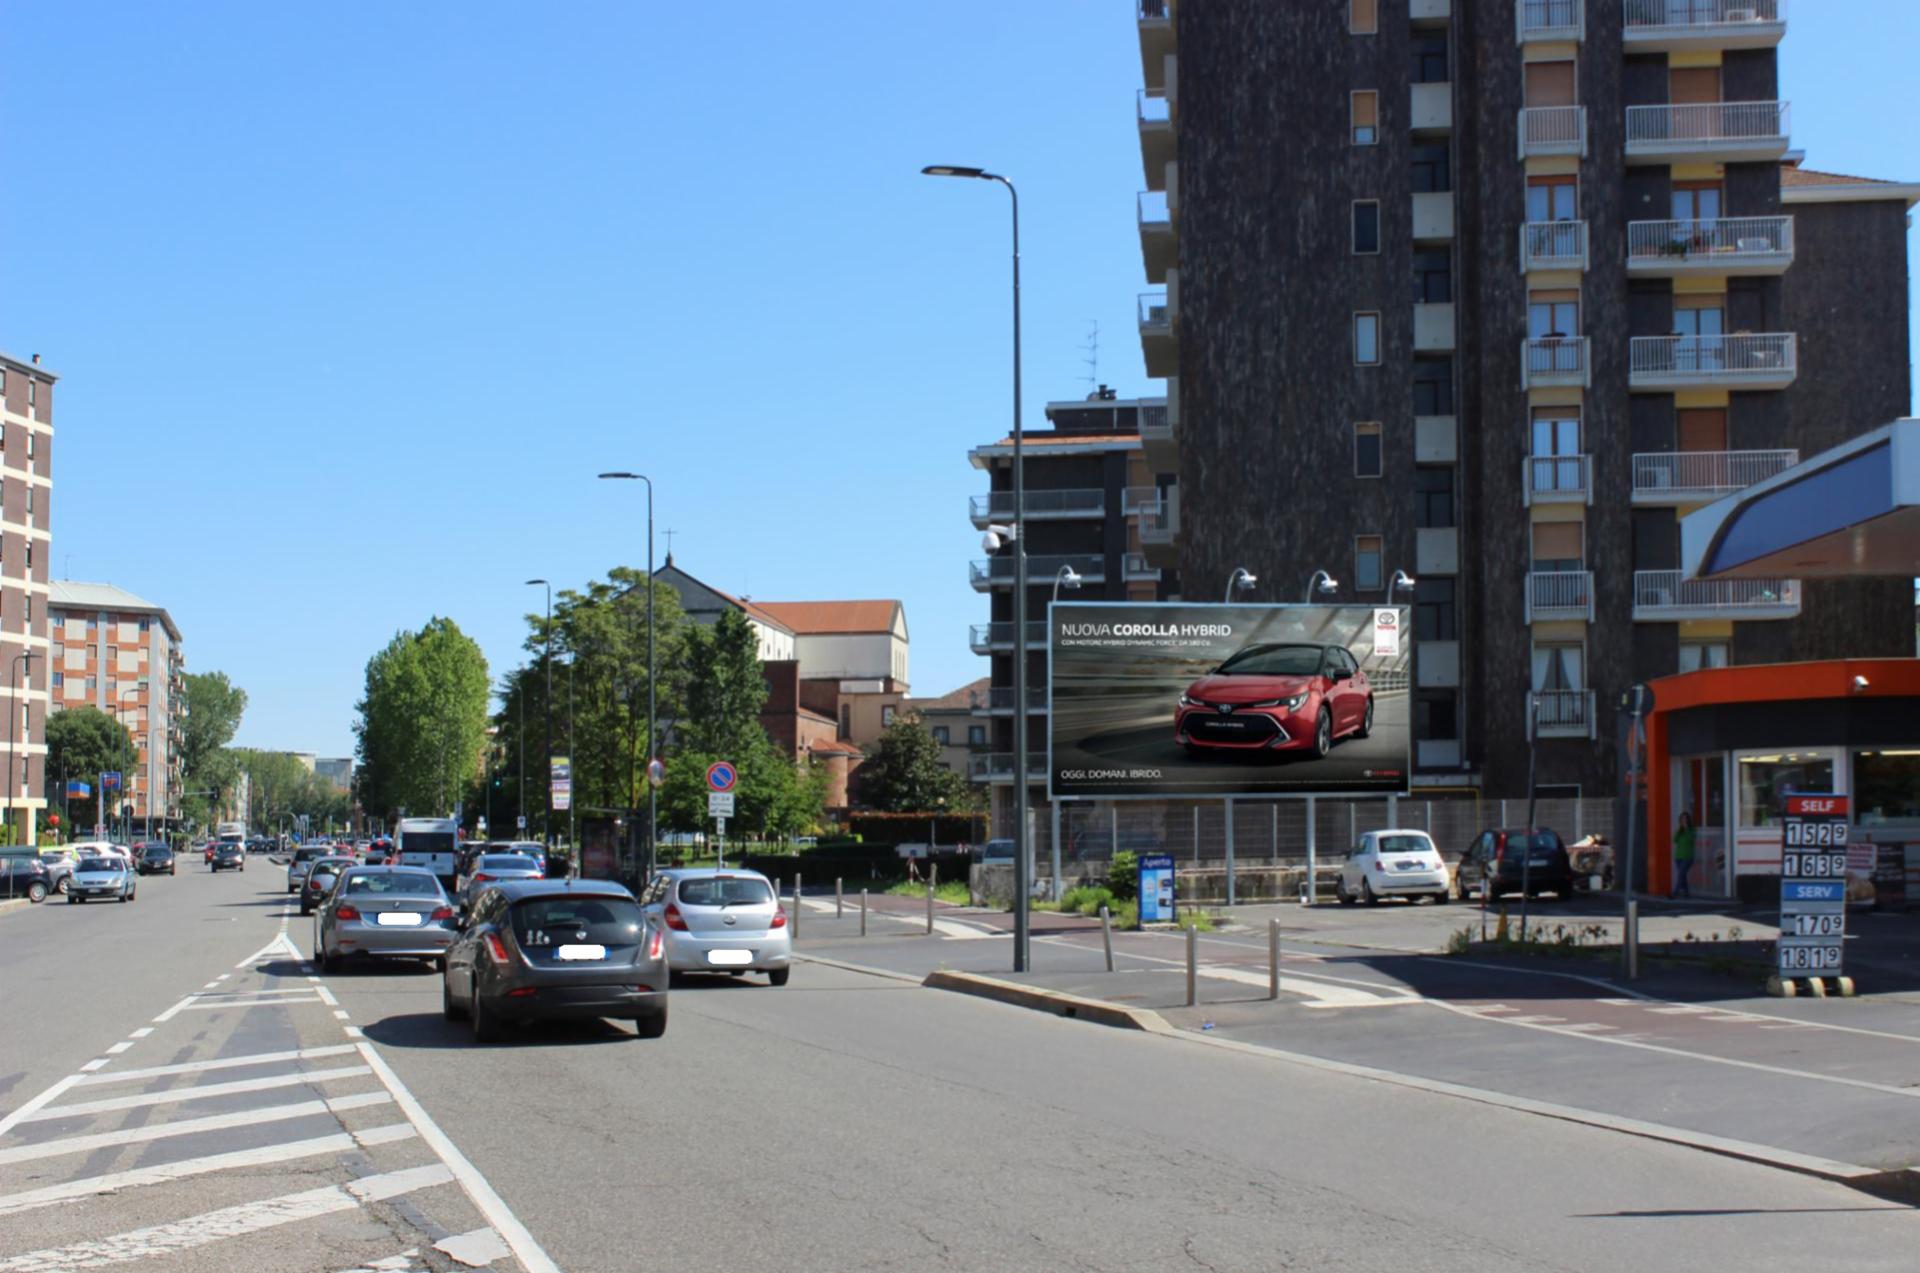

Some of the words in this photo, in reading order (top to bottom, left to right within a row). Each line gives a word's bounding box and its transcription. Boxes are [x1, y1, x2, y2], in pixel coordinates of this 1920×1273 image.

[1062, 623, 1111, 636] NUOVA
[1113, 624, 1179, 636] COROLLA
[1181, 624, 1232, 636] HYBRID
[1061, 769, 1086, 779] OGGI.
[1801, 800, 1835, 812] SELF
[1143, 858, 1171, 868] Aperto
[1797, 886, 1833, 898] SERV
